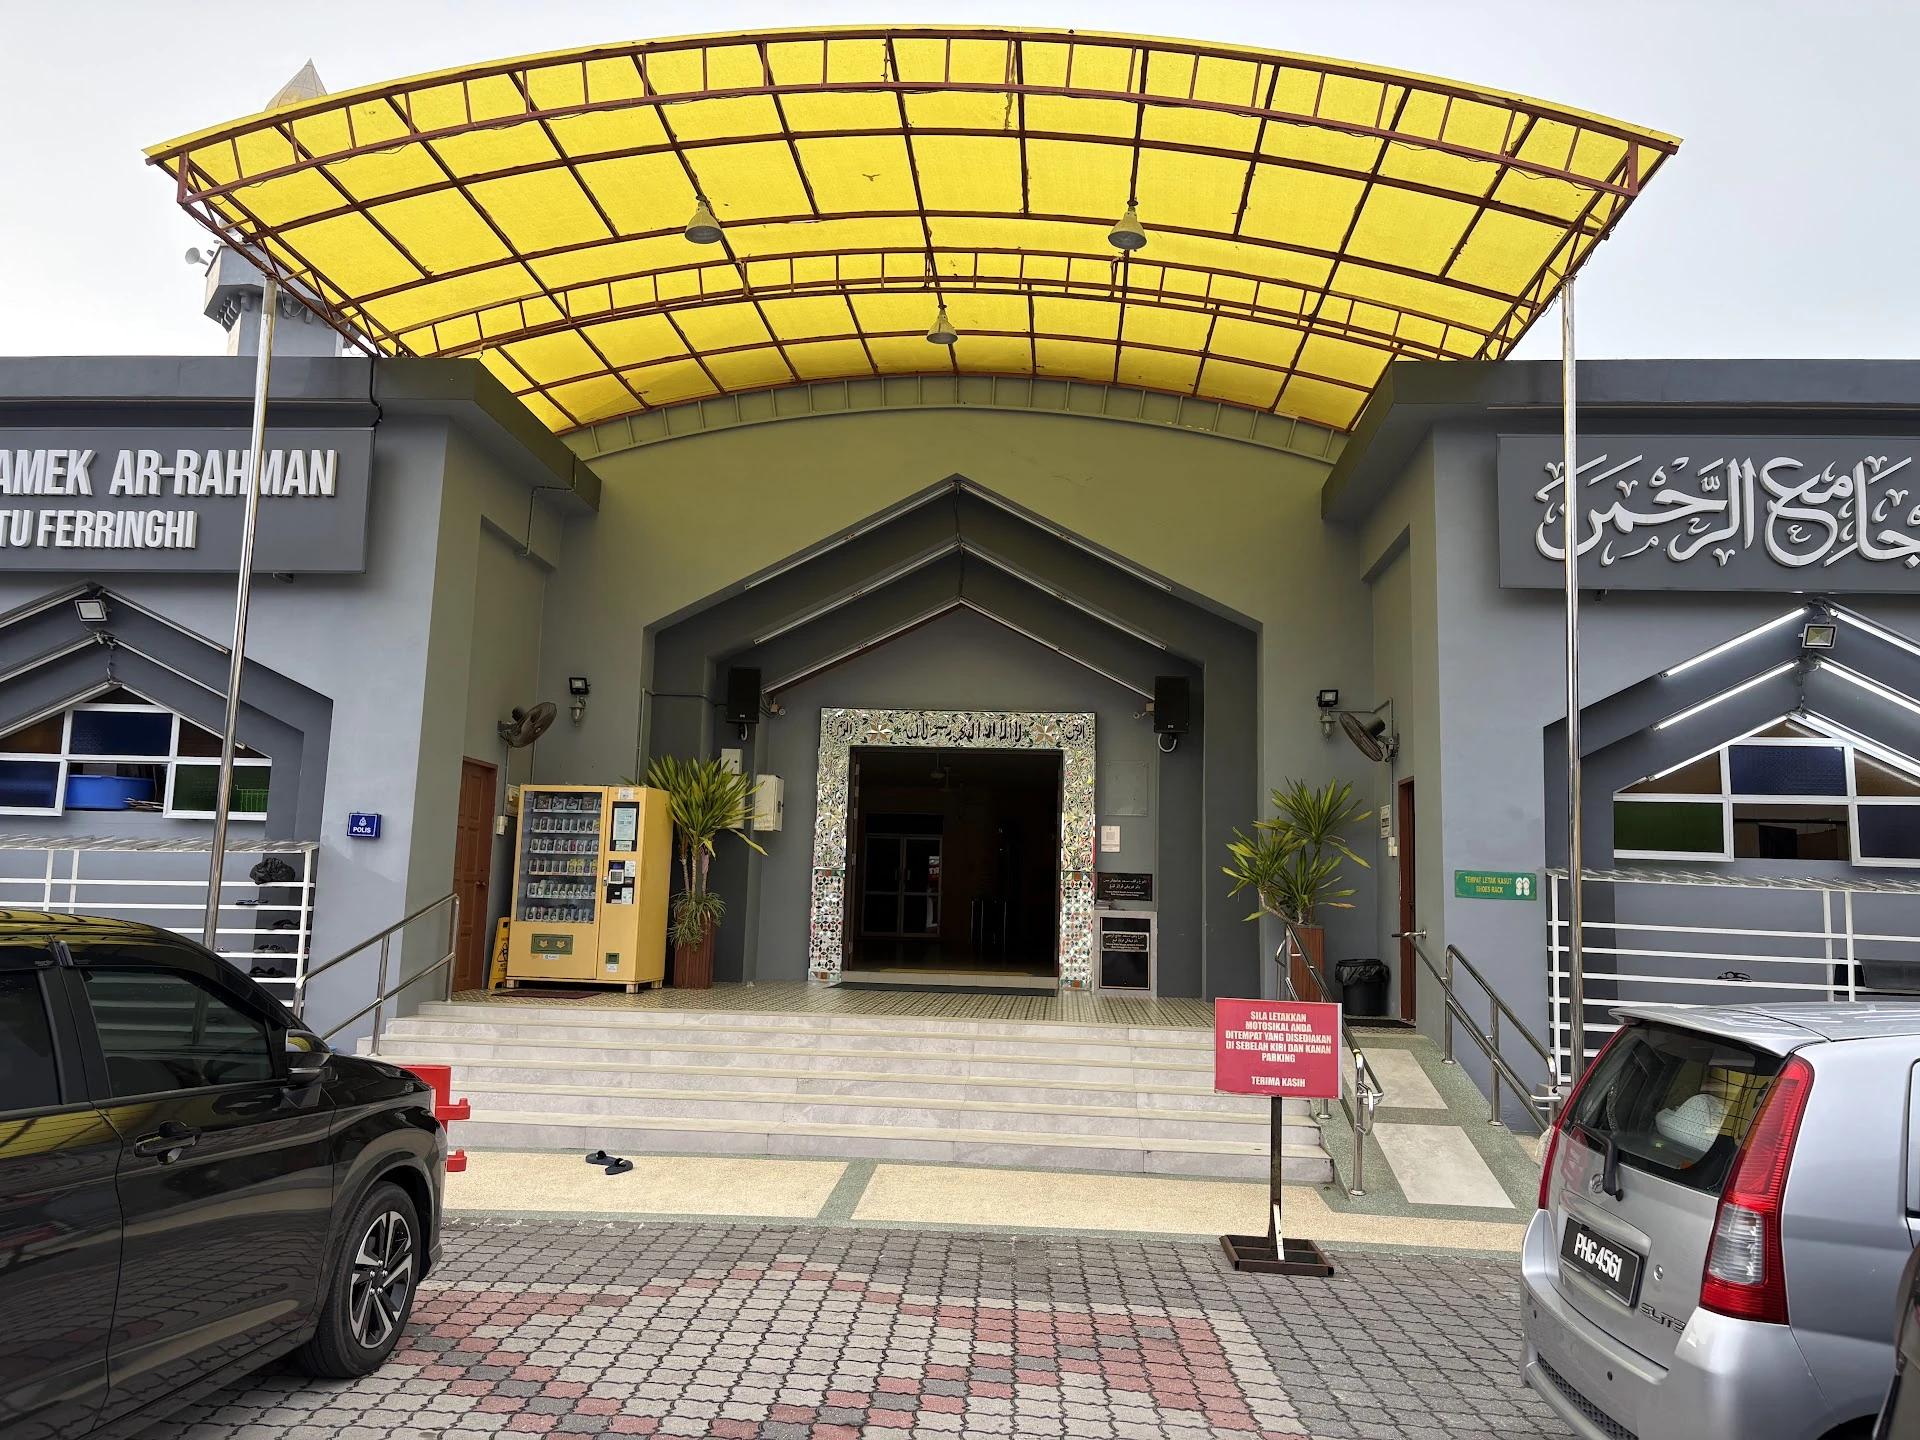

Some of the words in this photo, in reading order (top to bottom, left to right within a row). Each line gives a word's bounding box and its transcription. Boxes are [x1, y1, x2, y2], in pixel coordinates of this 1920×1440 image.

[109, 449, 338, 496] AR-RAHMAN
[37, 509, 199, 549] FERRINGHI
[1465, 876, 1481, 884] TEMPAT
[1482, 876, 1496, 884] LETAK
[1497, 877, 1512, 885] KASUT
[1250, 1011, 1268, 1021] SILA
[1269, 1012, 1307, 1022] LETAKKAN
[1245, 1021, 1290, 1032] MOTOSIKAL
[1291, 1022, 1312, 1033] ANDA
[1225, 1030, 1263, 1041] DITEMPAT
[1263, 1032, 1284, 1042] YANG
[1286, 1033, 1332, 1044] DISEDIAKAN
[1226, 1041, 1234, 1050] DI
[1236, 1041, 1268, 1052] SEBELAH
[1270, 1043, 1286, 1053] KIRI
[1288, 1043, 1305, 1053] DAN
[1305, 1044, 1332, 1054] KANAN
[1261, 1052, 1296, 1063] PARKING
[1251, 1076, 1280, 1086] TERIMA
[1281, 1077, 1306, 1088] KASIH
[1640, 1302, 1687, 1335] ELITE
